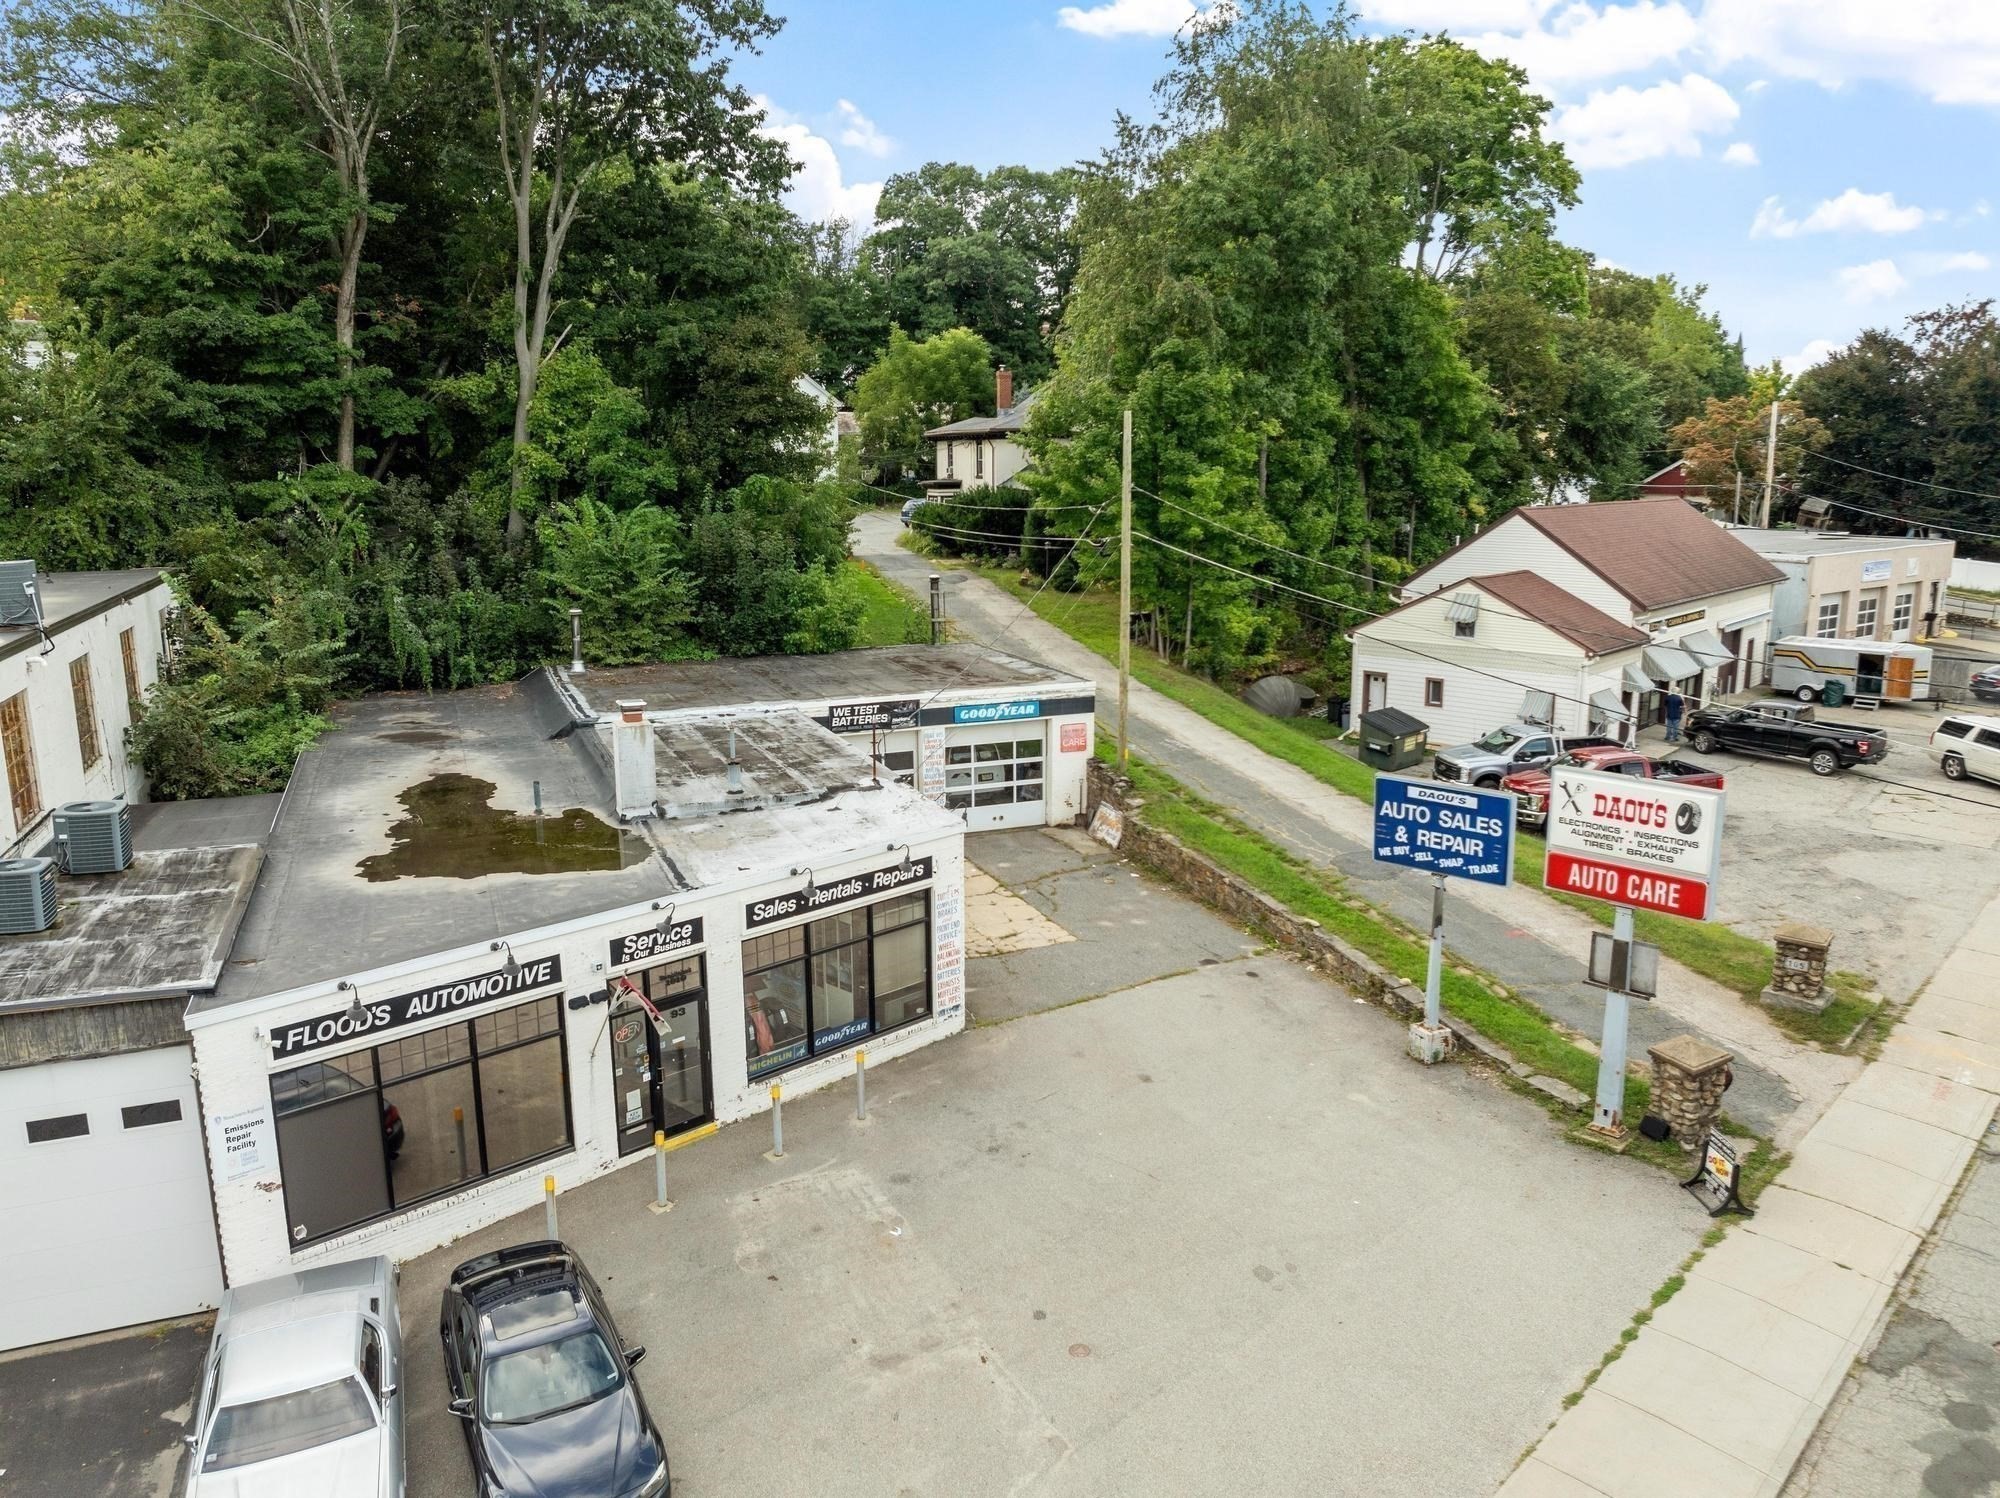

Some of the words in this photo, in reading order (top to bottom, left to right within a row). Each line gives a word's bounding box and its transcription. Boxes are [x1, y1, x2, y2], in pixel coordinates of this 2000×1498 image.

[832, 714, 888, 727] BATTERIES
[833, 707, 851, 717] WE
[854, 705, 880, 716] TEST
[960, 704, 1035, 719] GOODYEAR
[1062, 739, 1086, 747] CARE
[1418, 790, 1467, 805] DAOU'S
[1380, 800, 1431, 824] AUTO
[1438, 810, 1503, 837] SALES
[1593, 793, 1668, 829] DAOU'S
[1395, 825, 1408, 843] &
[1416, 829, 1484, 857] REPAIR
[1558, 817, 1621, 834] ELECTRONICS
[1634, 830, 1699, 849] INSPECTIONS
[1571, 828, 1624, 844] ALIGNMENT
[1637, 840, 1685, 856] EXHAUST
[1378, 847, 1391, 856] WE
[1393, 846, 1410, 856] BUY
[1414, 852, 1434, 861] SELL
[1439, 858, 1464, 867] SWAP
[1468, 864, 1499, 874] TRADE
[1584, 839, 1613, 851] TIRES
[1626, 848, 1674, 863] BRAKES
[753, 898, 797, 921] Sales
[808, 878, 862, 906] Rentals
[873, 863, 924, 889] Repairs
[1568, 863, 1618, 894] AUTO
[1627, 875, 1681, 908] CARE
[621, 953, 630, 962] Is
[634, 948, 650, 959] Our
[654, 938, 691, 954] Business
[623, 924, 692, 954] Service
[405, 961, 552, 1018] AUTOMOTIVE
[671, 1007, 685, 1018] 93
[286, 1005, 391, 1051] FLOOD'S
[615, 1024, 640, 1041] OPEN
[749, 1050, 793, 1072] MICHELIN
[815, 1022, 868, 1046] GOODYEAR
[224, 1118, 265, 1135] Emissions
[226, 1131, 252, 1144] Repair
[227, 1140, 257, 1153] Facility
